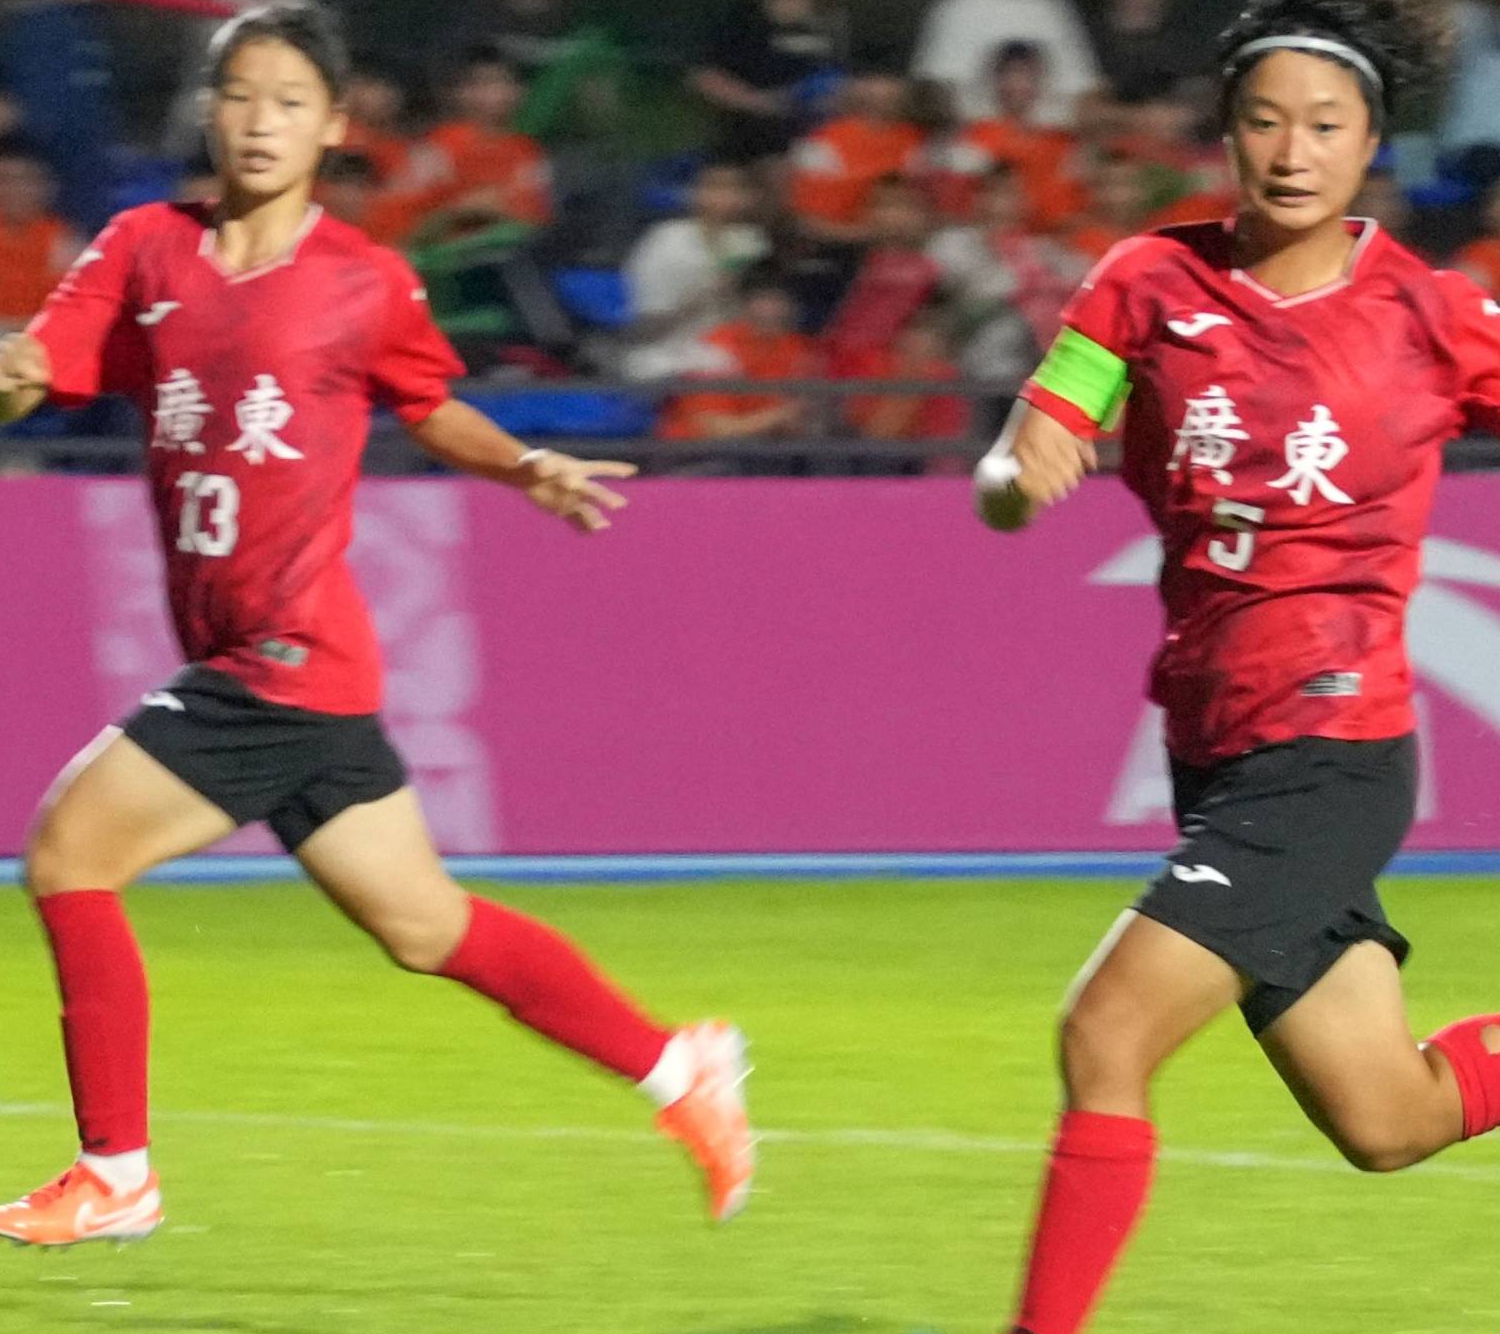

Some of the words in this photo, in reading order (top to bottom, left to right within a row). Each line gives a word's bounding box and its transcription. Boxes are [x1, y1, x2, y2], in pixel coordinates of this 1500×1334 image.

[151, 368, 305, 465] 廣東
[1165, 384, 1356, 506] 廣東
[175, 471, 240, 557] 13
[1207, 497, 1265, 571] 5
